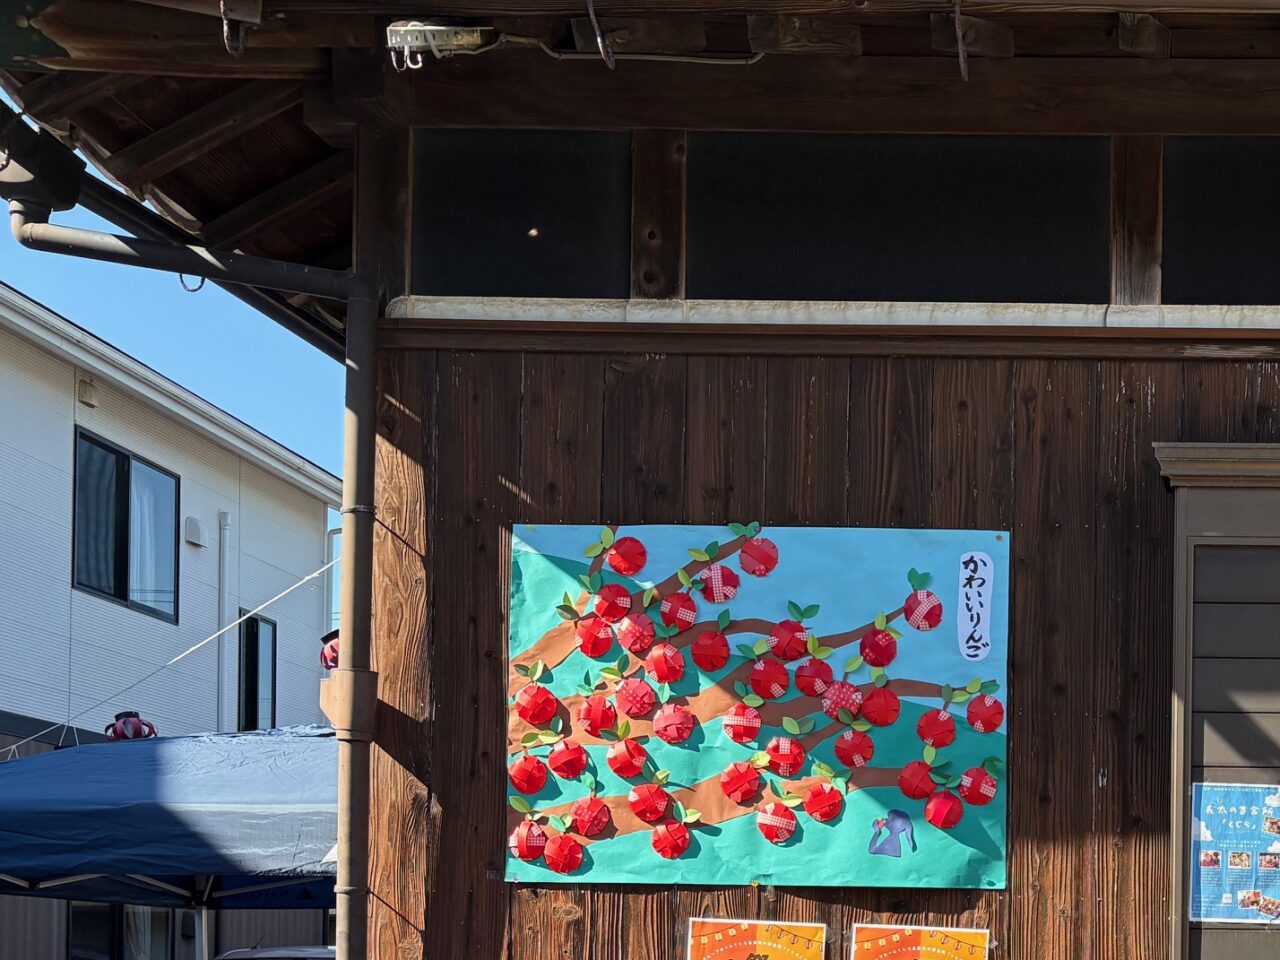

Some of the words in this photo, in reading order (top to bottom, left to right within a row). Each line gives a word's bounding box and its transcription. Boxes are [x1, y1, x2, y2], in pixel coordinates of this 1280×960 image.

[962, 555, 989, 658] かわいいりんご
